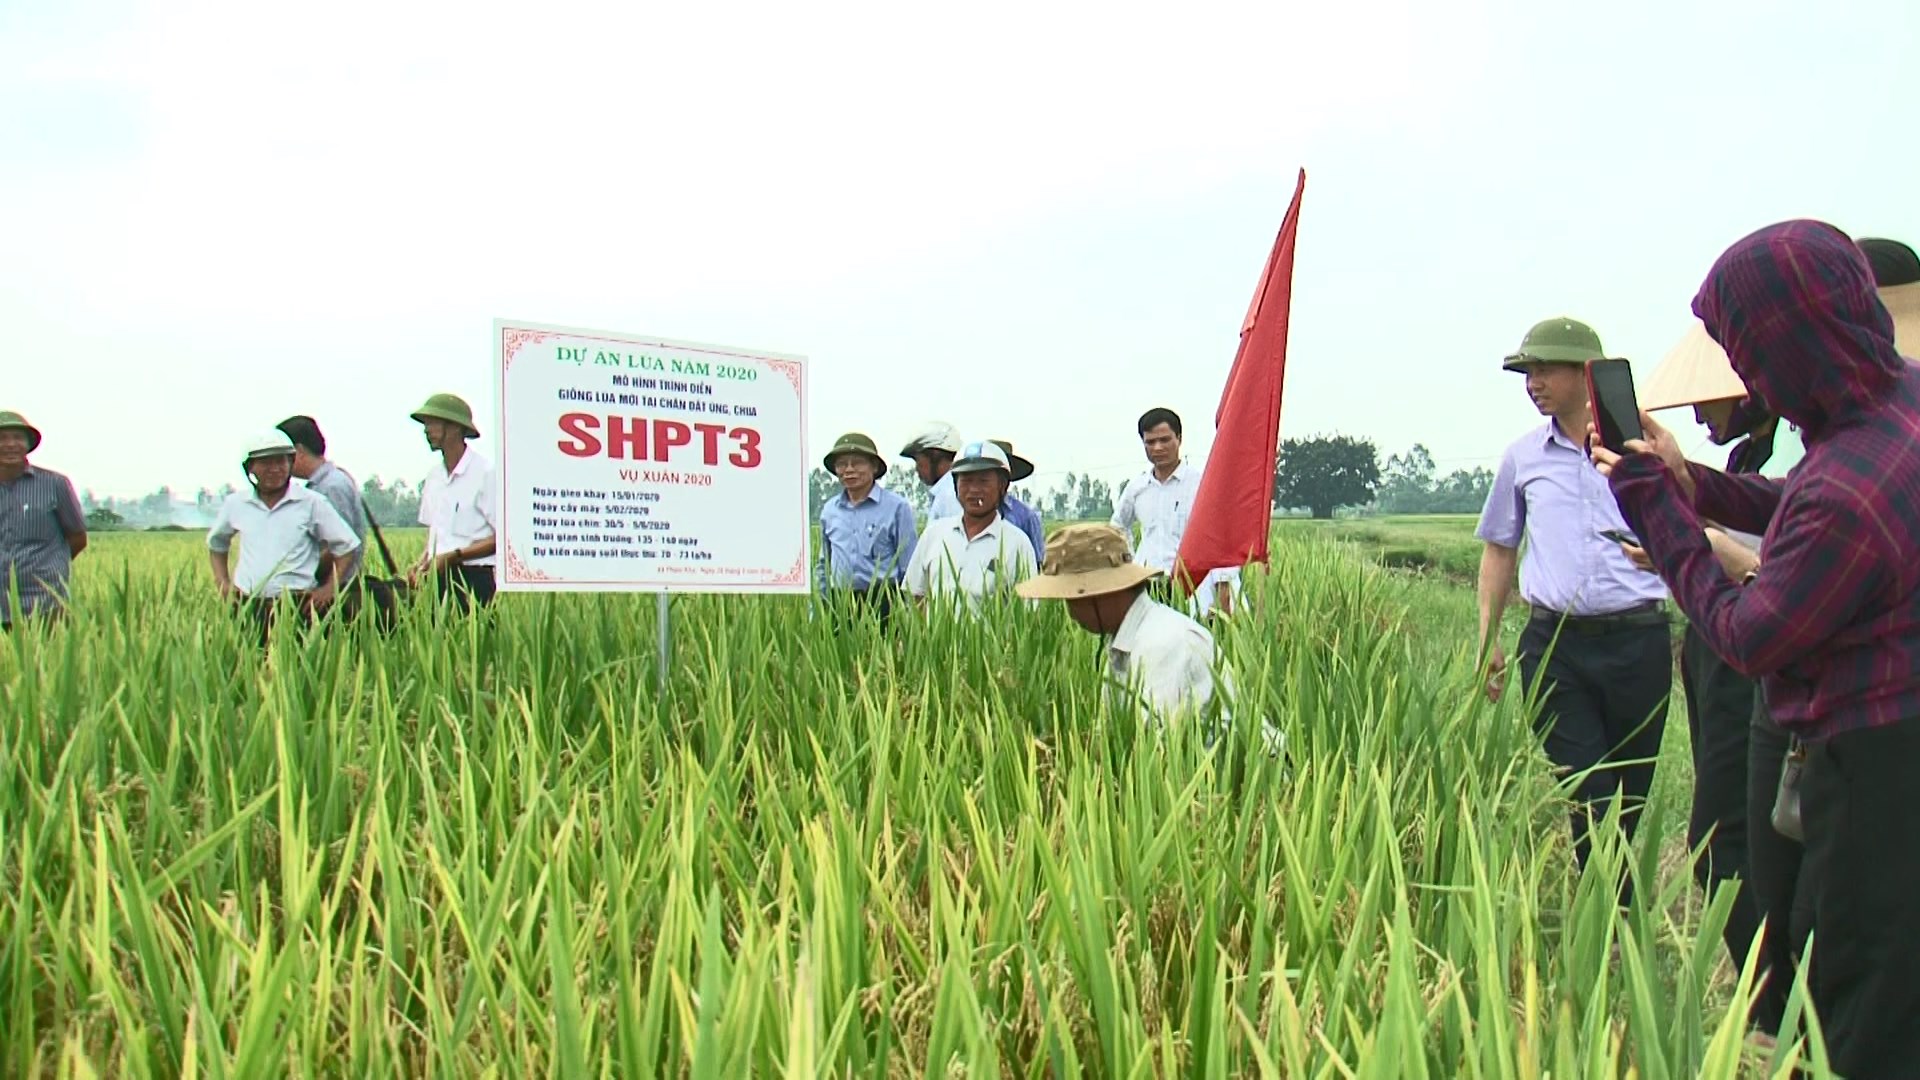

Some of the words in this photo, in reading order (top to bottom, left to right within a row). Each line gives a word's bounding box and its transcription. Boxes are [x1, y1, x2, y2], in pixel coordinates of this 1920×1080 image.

[557, 347, 587, 366] DỰ
[716, 365, 757, 381] 2020
[558, 412, 761, 468] SHPT3
[619, 469, 638, 483] VỤ
[684, 473, 711, 486] 2020
